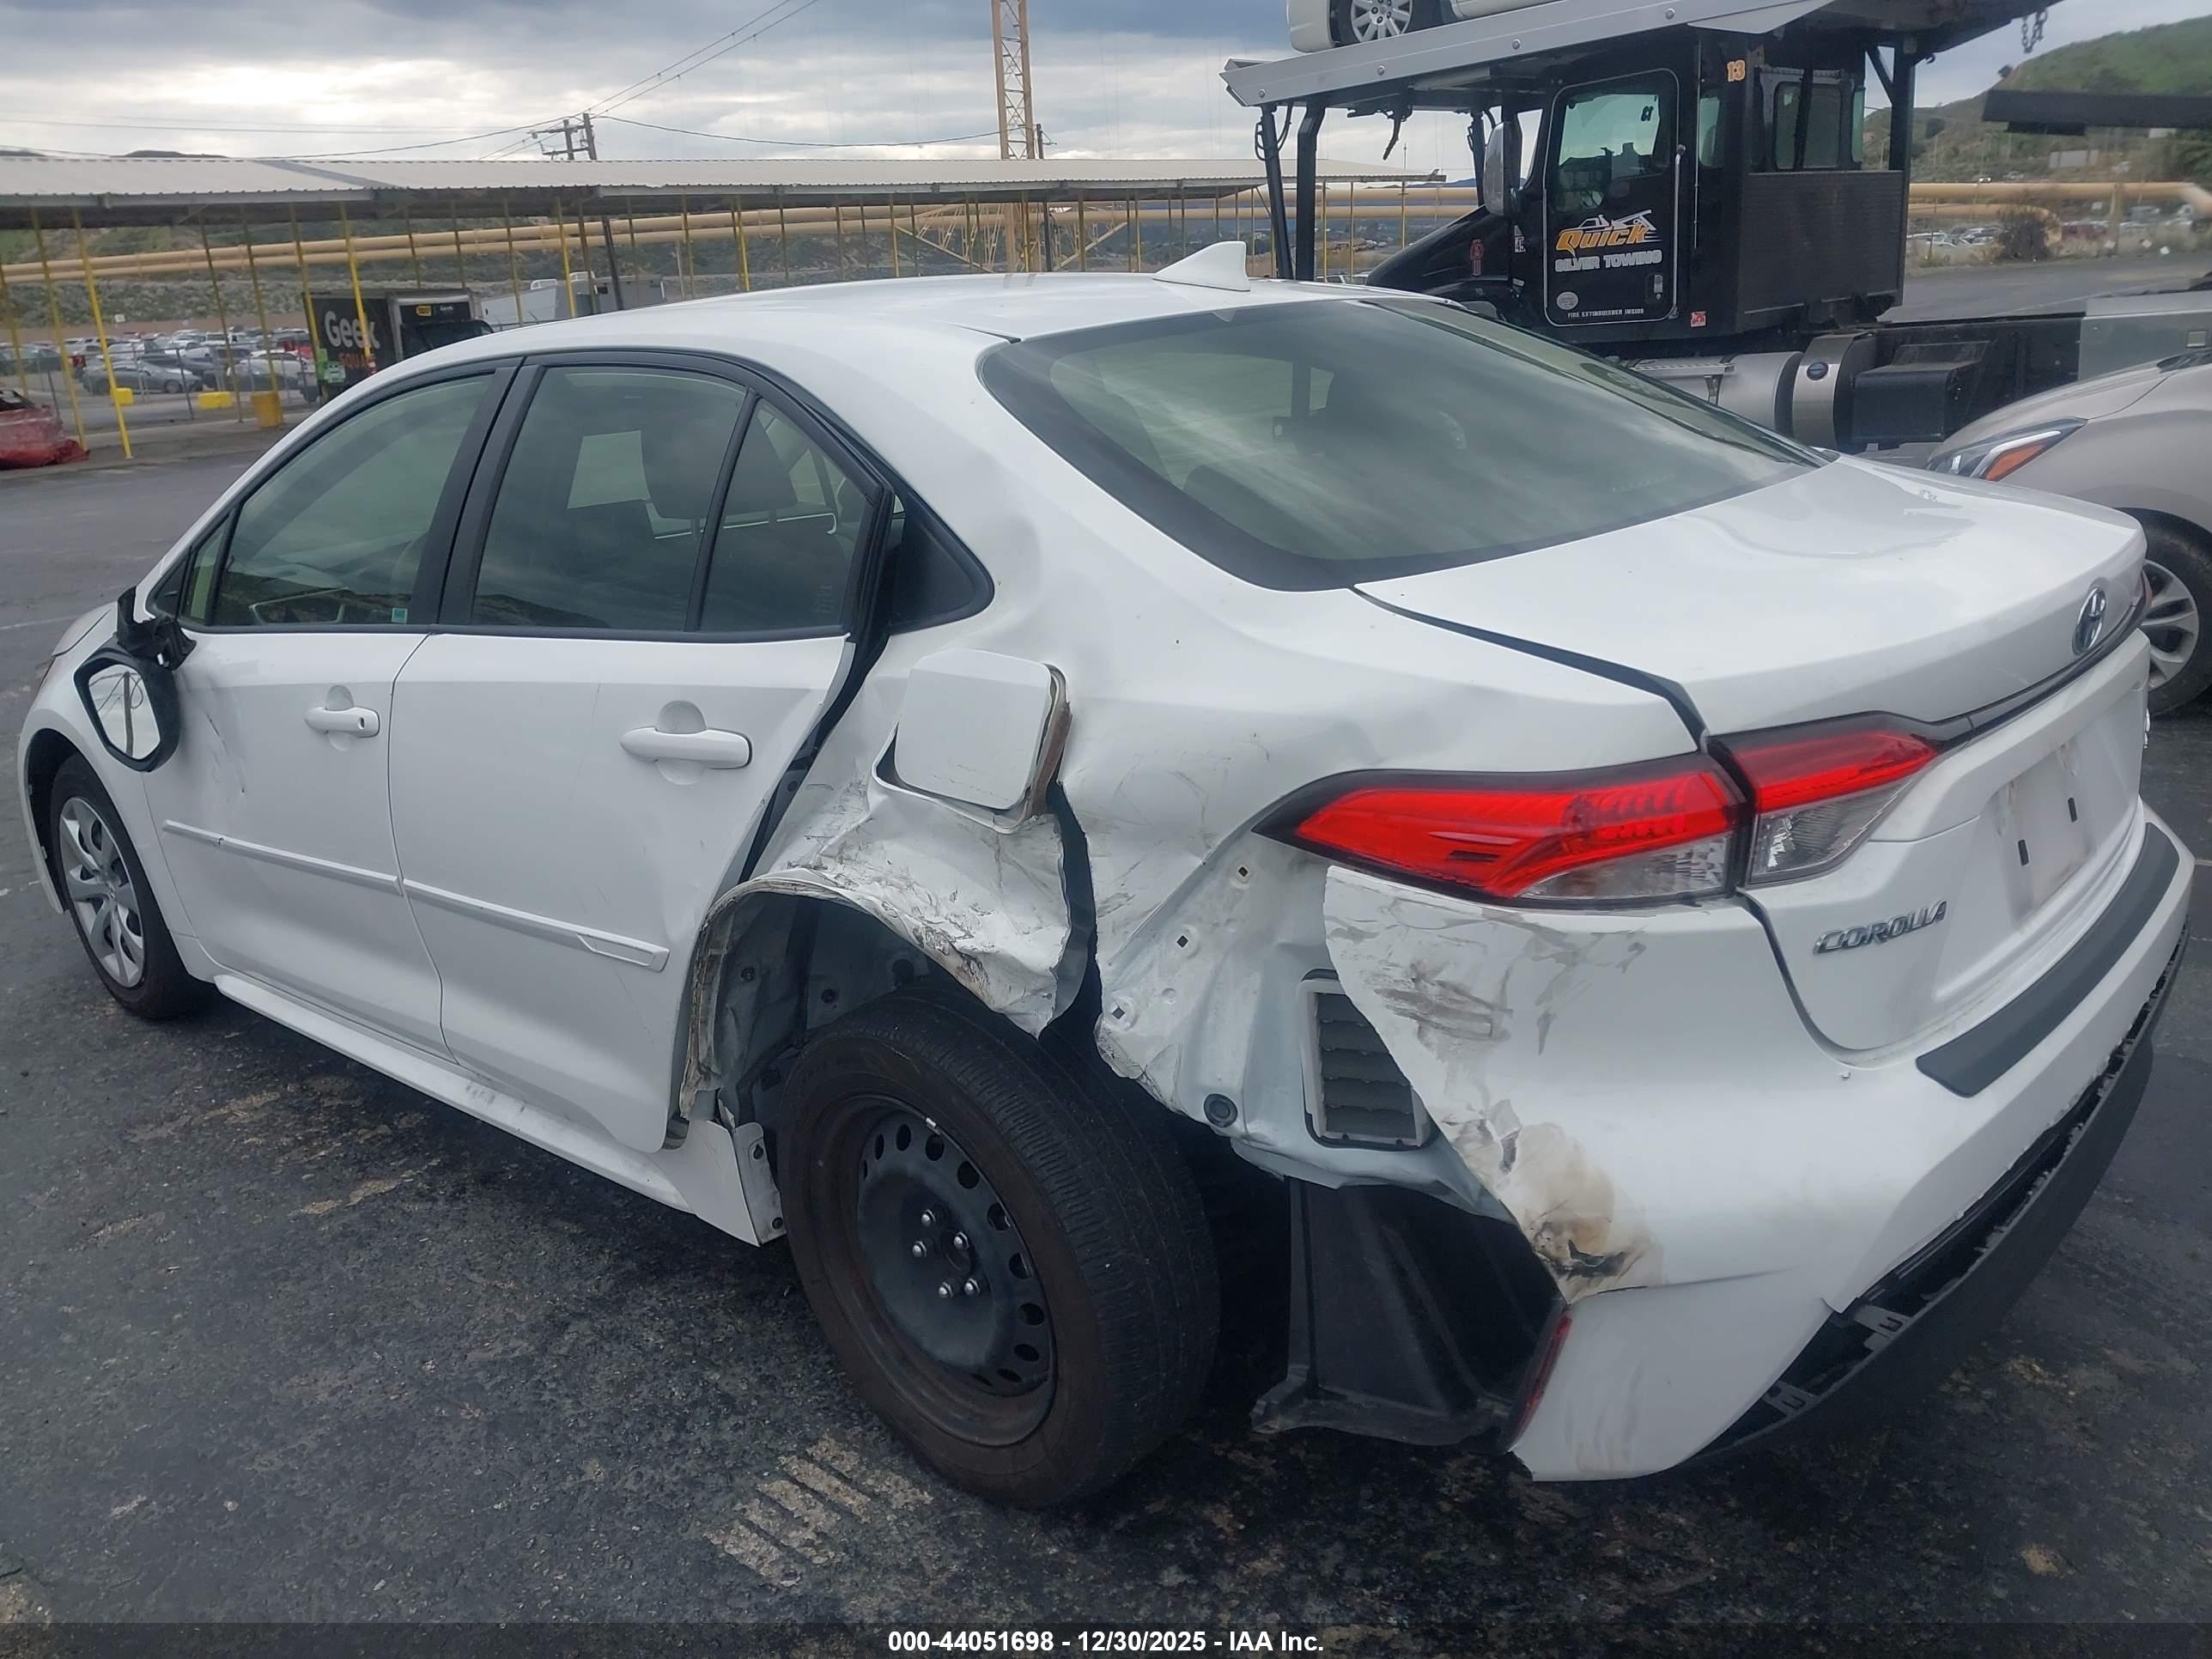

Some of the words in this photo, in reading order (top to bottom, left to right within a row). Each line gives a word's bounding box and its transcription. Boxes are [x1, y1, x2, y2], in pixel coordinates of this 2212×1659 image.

[1727, 59, 1746, 82] 13
[1555, 256, 1600, 272] SILVER
[1603, 249, 1662, 268] TOWING
[324, 310, 380, 349] Geek
[1813, 900, 1947, 954] COROLLA
